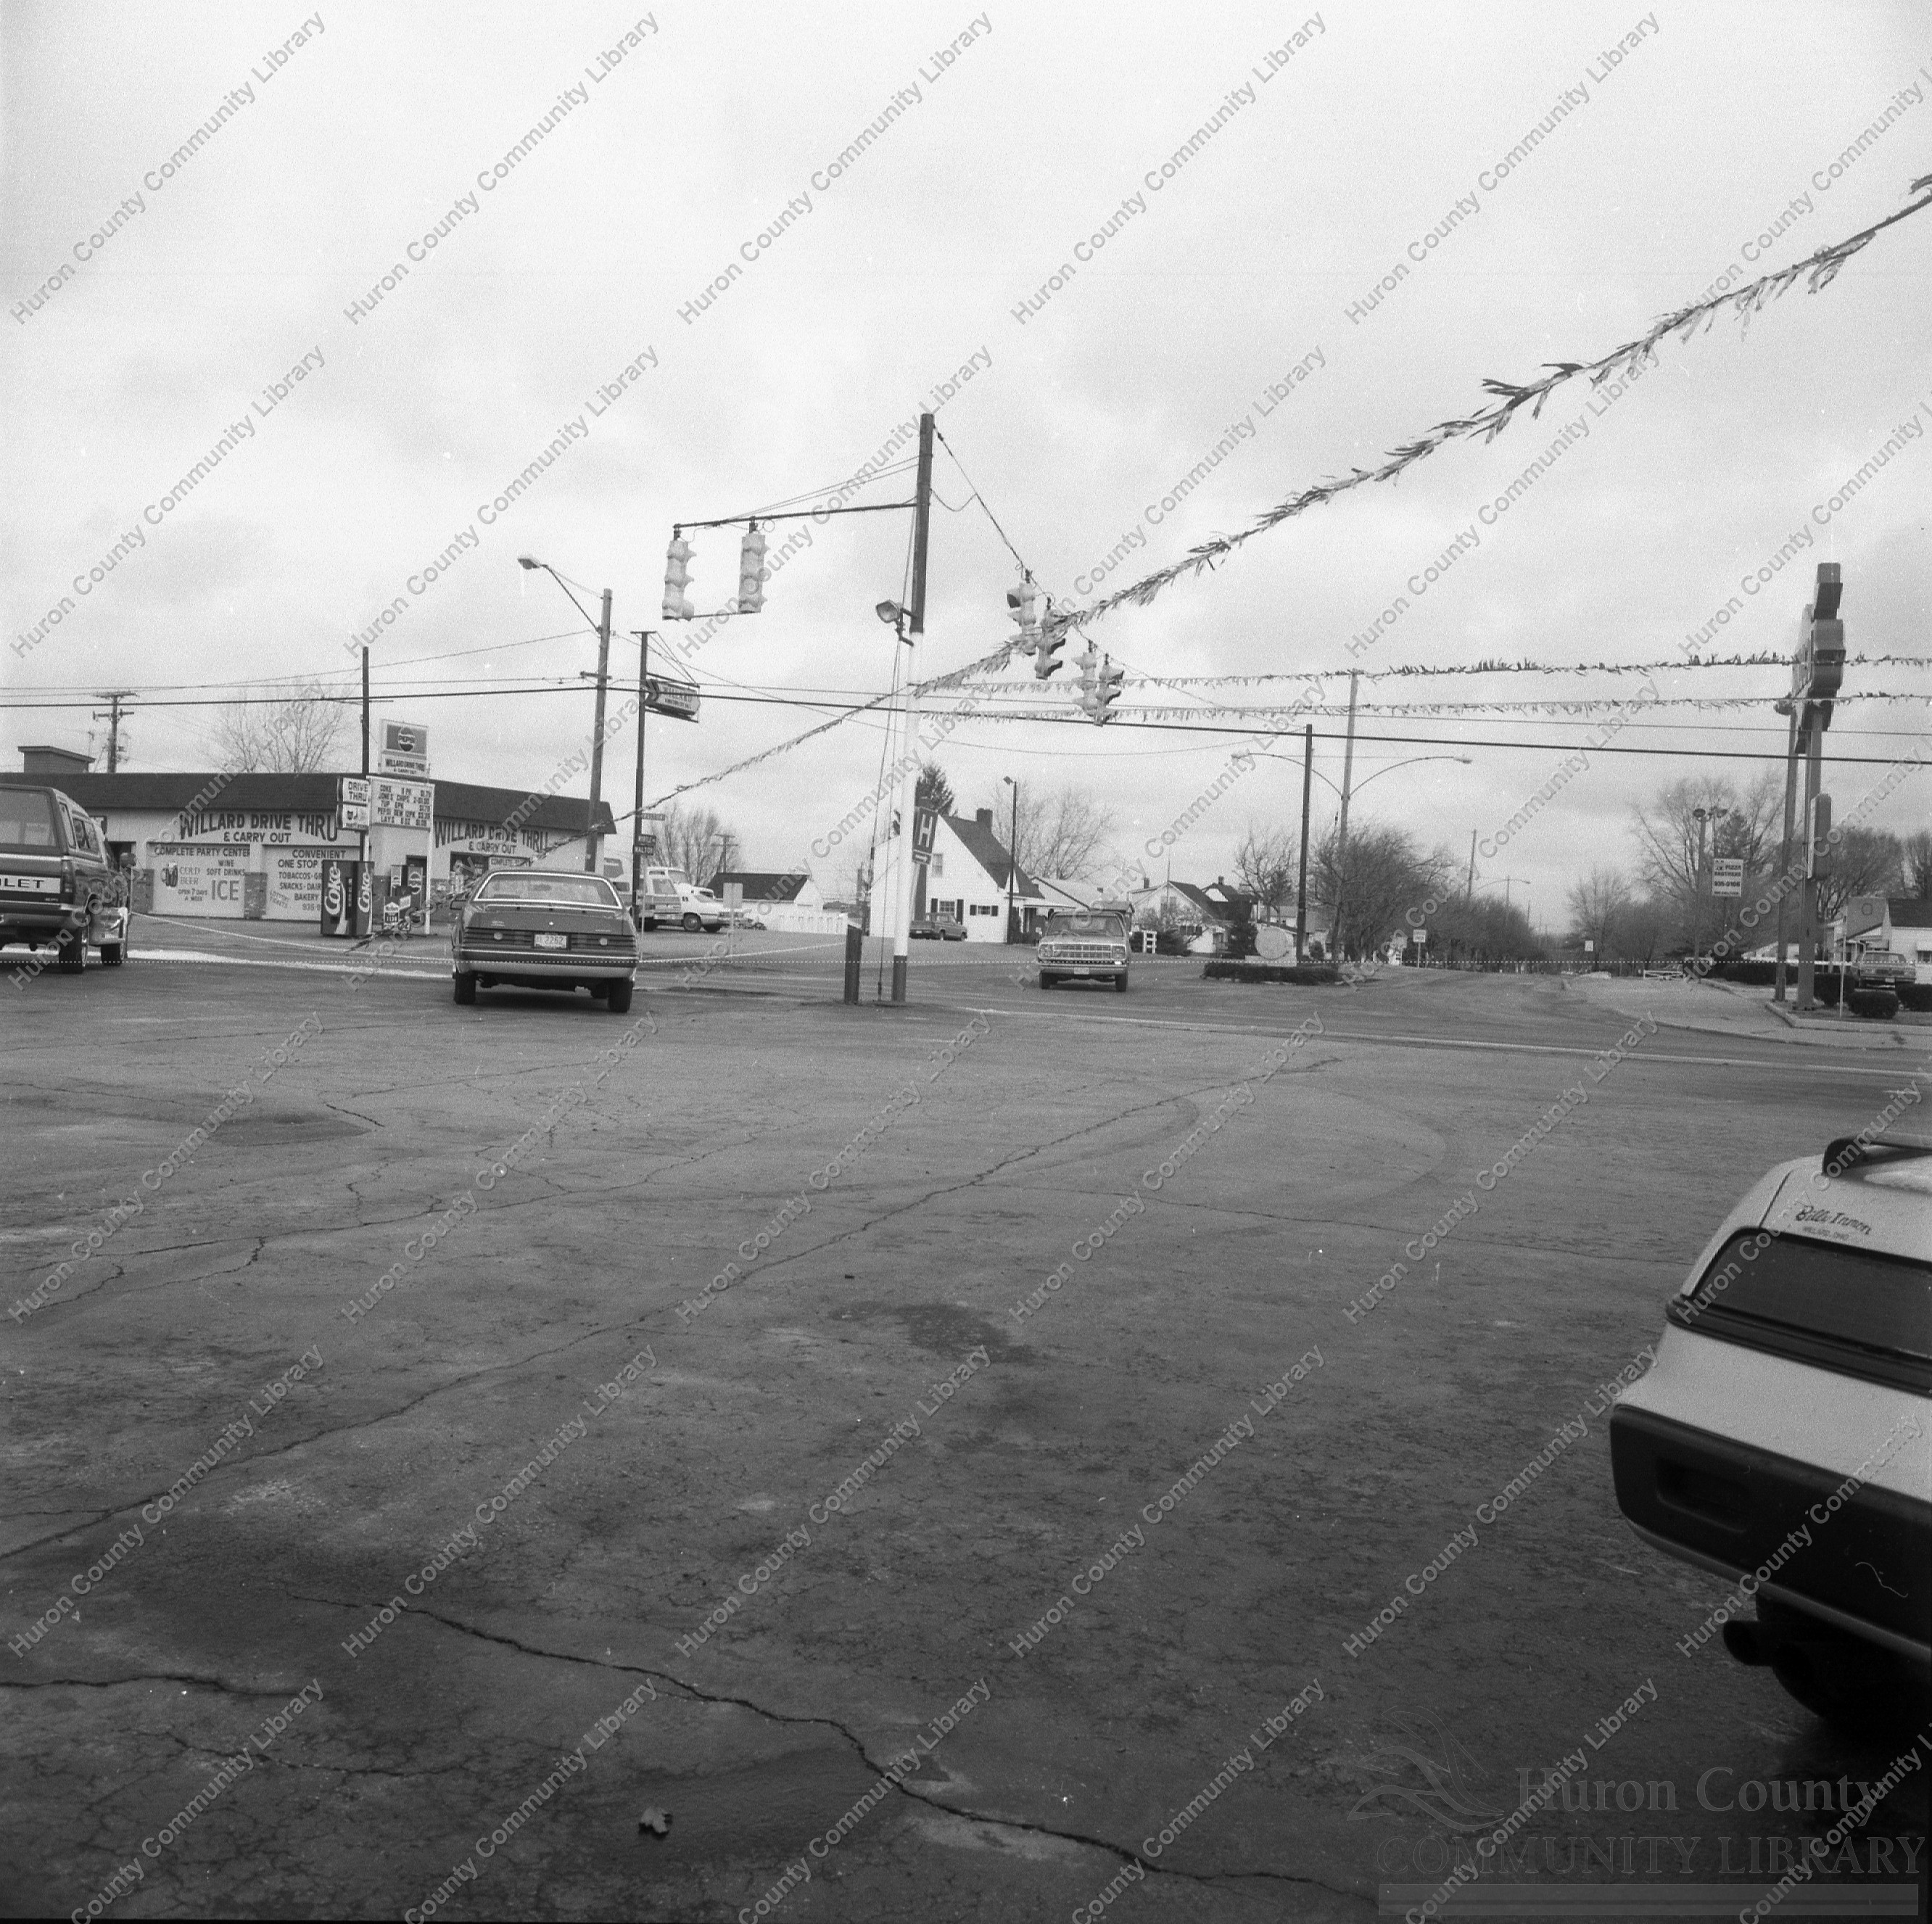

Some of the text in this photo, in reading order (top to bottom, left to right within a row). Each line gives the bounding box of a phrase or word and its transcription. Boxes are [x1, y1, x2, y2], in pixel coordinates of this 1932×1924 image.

[348, 781, 368, 793] DRIVE
[380, 784, 392, 793] COKE
[349, 791, 367, 801] THRU
[180, 813, 338, 841] WILLARD DRIVE THRU
[917, 814, 933, 848] H
[223, 832, 292, 843] & CARRY OUT
[434, 821, 484, 849] WILLARD
[489, 826, 517, 843] DRIVE
[154, 846, 194, 856] COMPLETE
[197, 847, 220, 856] PARTY
[292, 849, 347, 859] CONVENIENT
[476, 843, 499, 853] CARRY
[502, 843, 516, 854] OUT
[278, 859, 318, 868] ONE STOP
[212, 880, 239, 901] ICE
[323, 864, 341, 915] Coke
[358, 868, 371, 913] Coke
